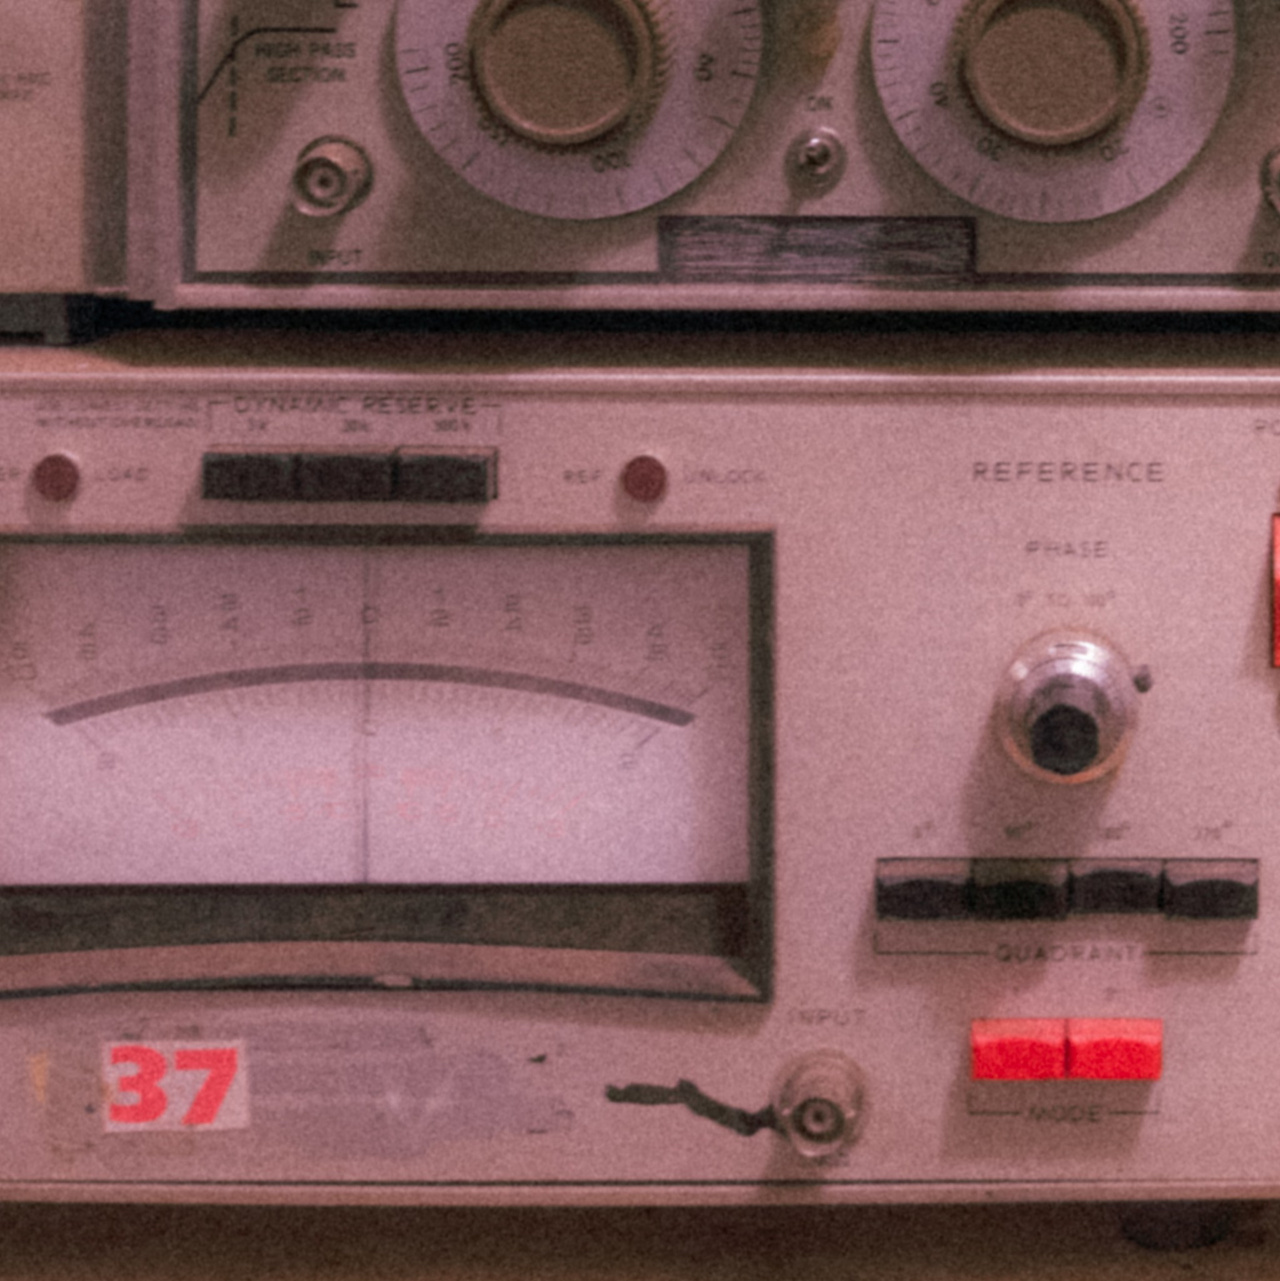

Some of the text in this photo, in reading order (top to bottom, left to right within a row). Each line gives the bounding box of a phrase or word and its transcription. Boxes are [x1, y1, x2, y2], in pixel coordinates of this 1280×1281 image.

[308, 42, 356, 58] PASS
[265, 66, 347, 83] SECTION
[233, 395, 478, 415] DYNAMIC RESERVE
[972, 461, 1166, 484] REFERENCE
[1024, 540, 1110, 559] PHASE
[994, 943, 1146, 963] QUADRANT
[108, 1044, 238, 1125] 37
